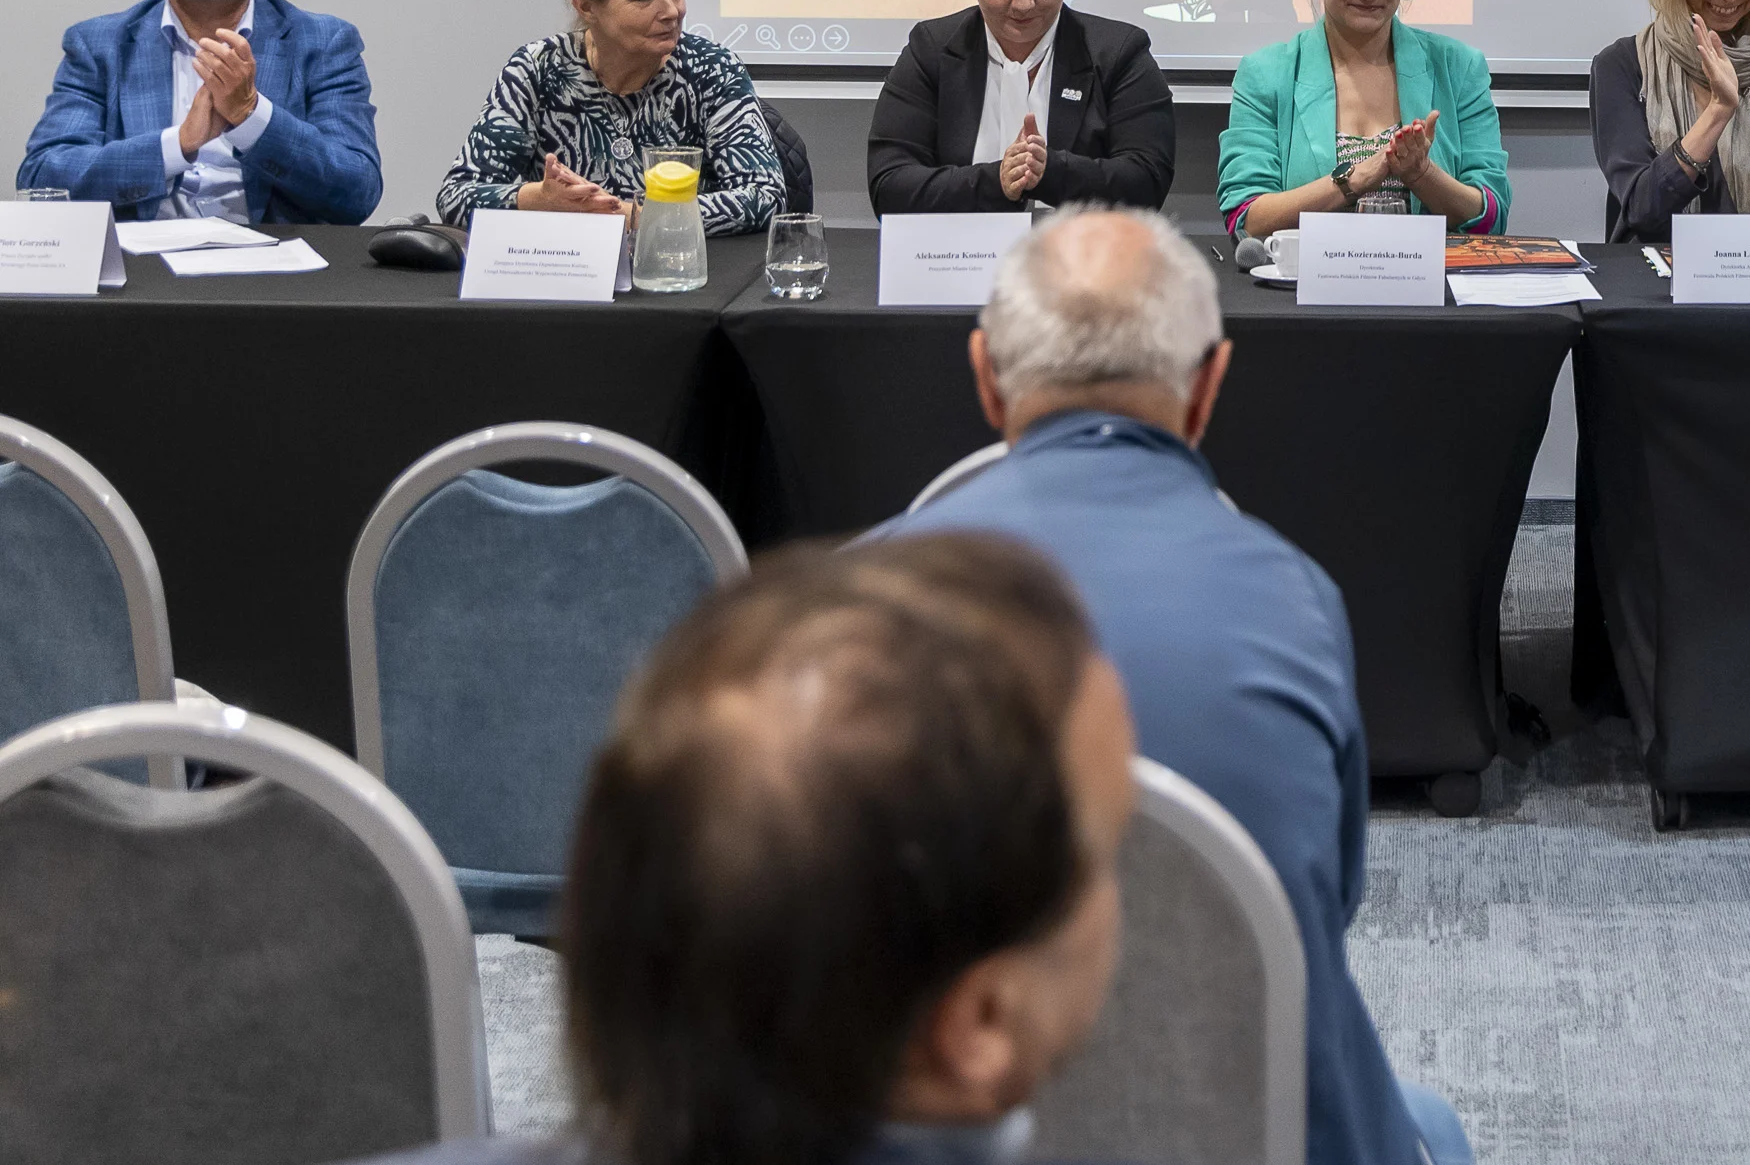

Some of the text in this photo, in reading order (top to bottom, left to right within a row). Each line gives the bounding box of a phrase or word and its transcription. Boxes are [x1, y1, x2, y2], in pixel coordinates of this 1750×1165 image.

[508, 246, 581, 257] Beata Jaworowska
[915, 251, 997, 260] Aleksandra Kosiorek
[1323, 250, 1345, 259] Agata
[1713, 250, 1742, 258] Joanna
